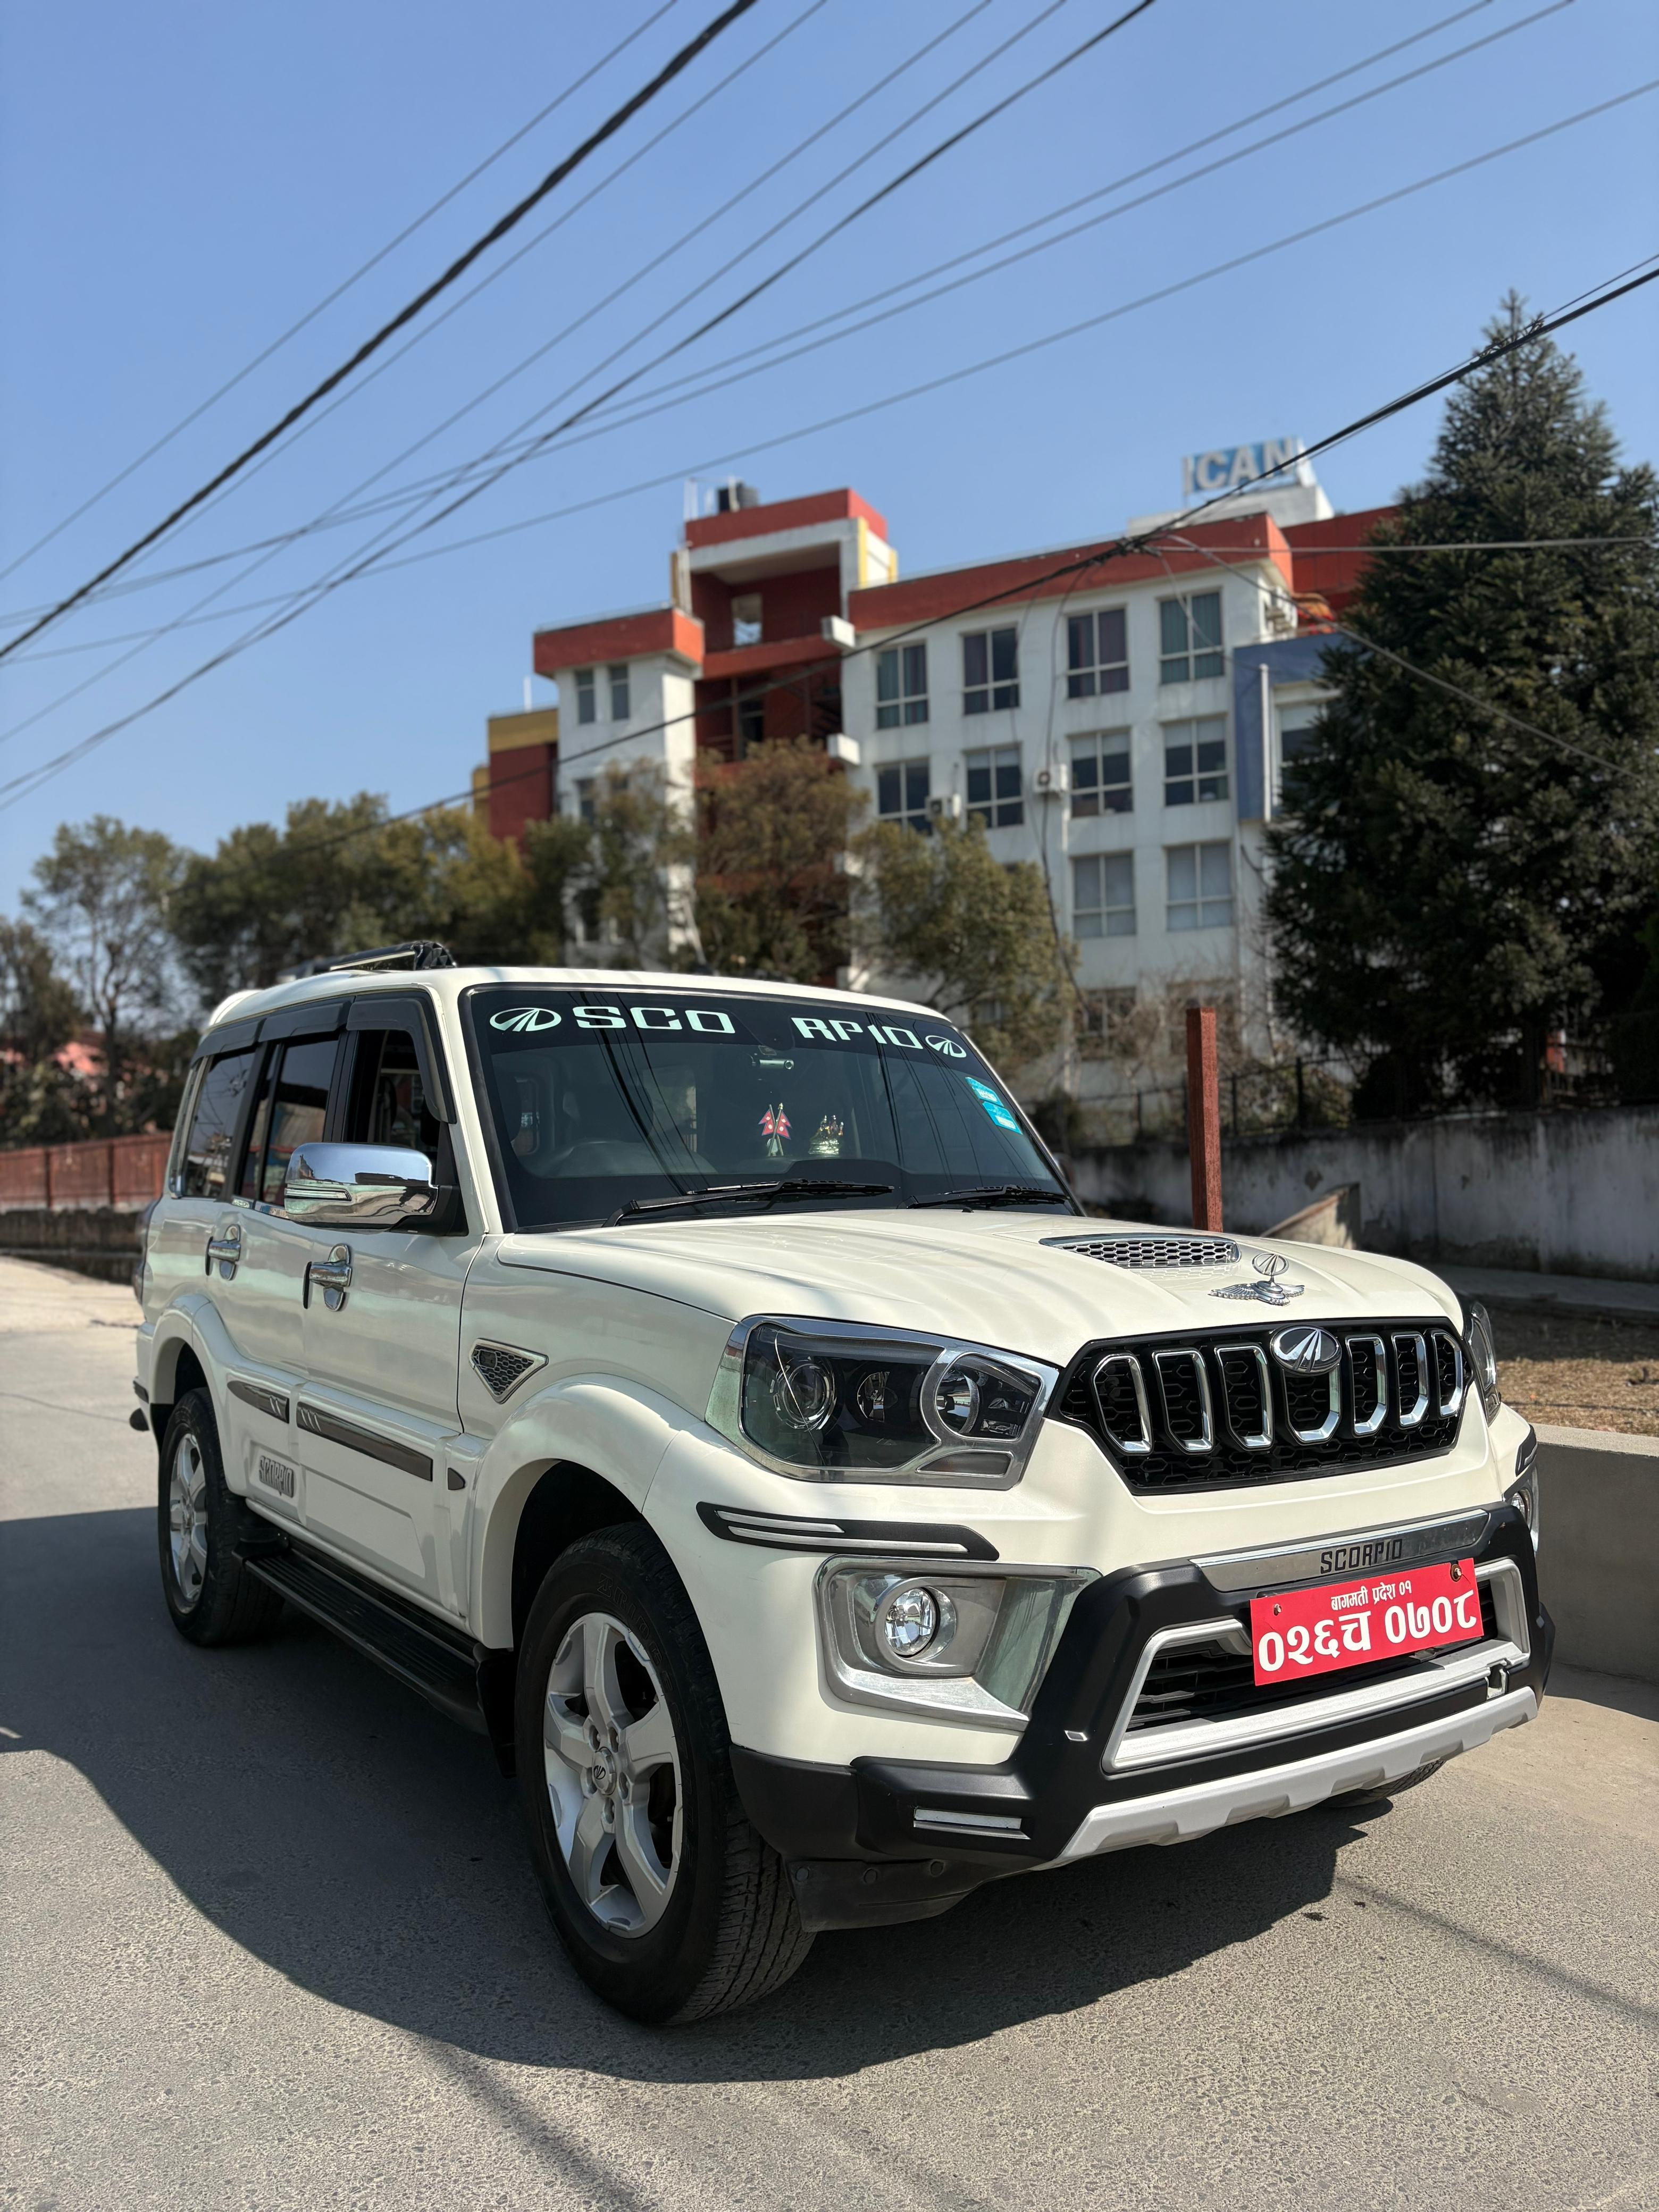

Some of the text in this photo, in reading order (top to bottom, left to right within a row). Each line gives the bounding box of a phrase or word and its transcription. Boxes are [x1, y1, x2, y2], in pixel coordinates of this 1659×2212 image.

[1182, 437, 1295, 495] ICAN
[573, 1007, 924, 1050] SCO RPIO
[259, 1455, 294, 1498] SCORPIO
[1320, 1539, 1403, 1574] SCORPIO
[1331, 1586, 1369, 1611] बागमती
[1372, 1582, 1396, 1605] प्रदेश
[1258, 1590, 1477, 1672] ०२६च ०७०८
